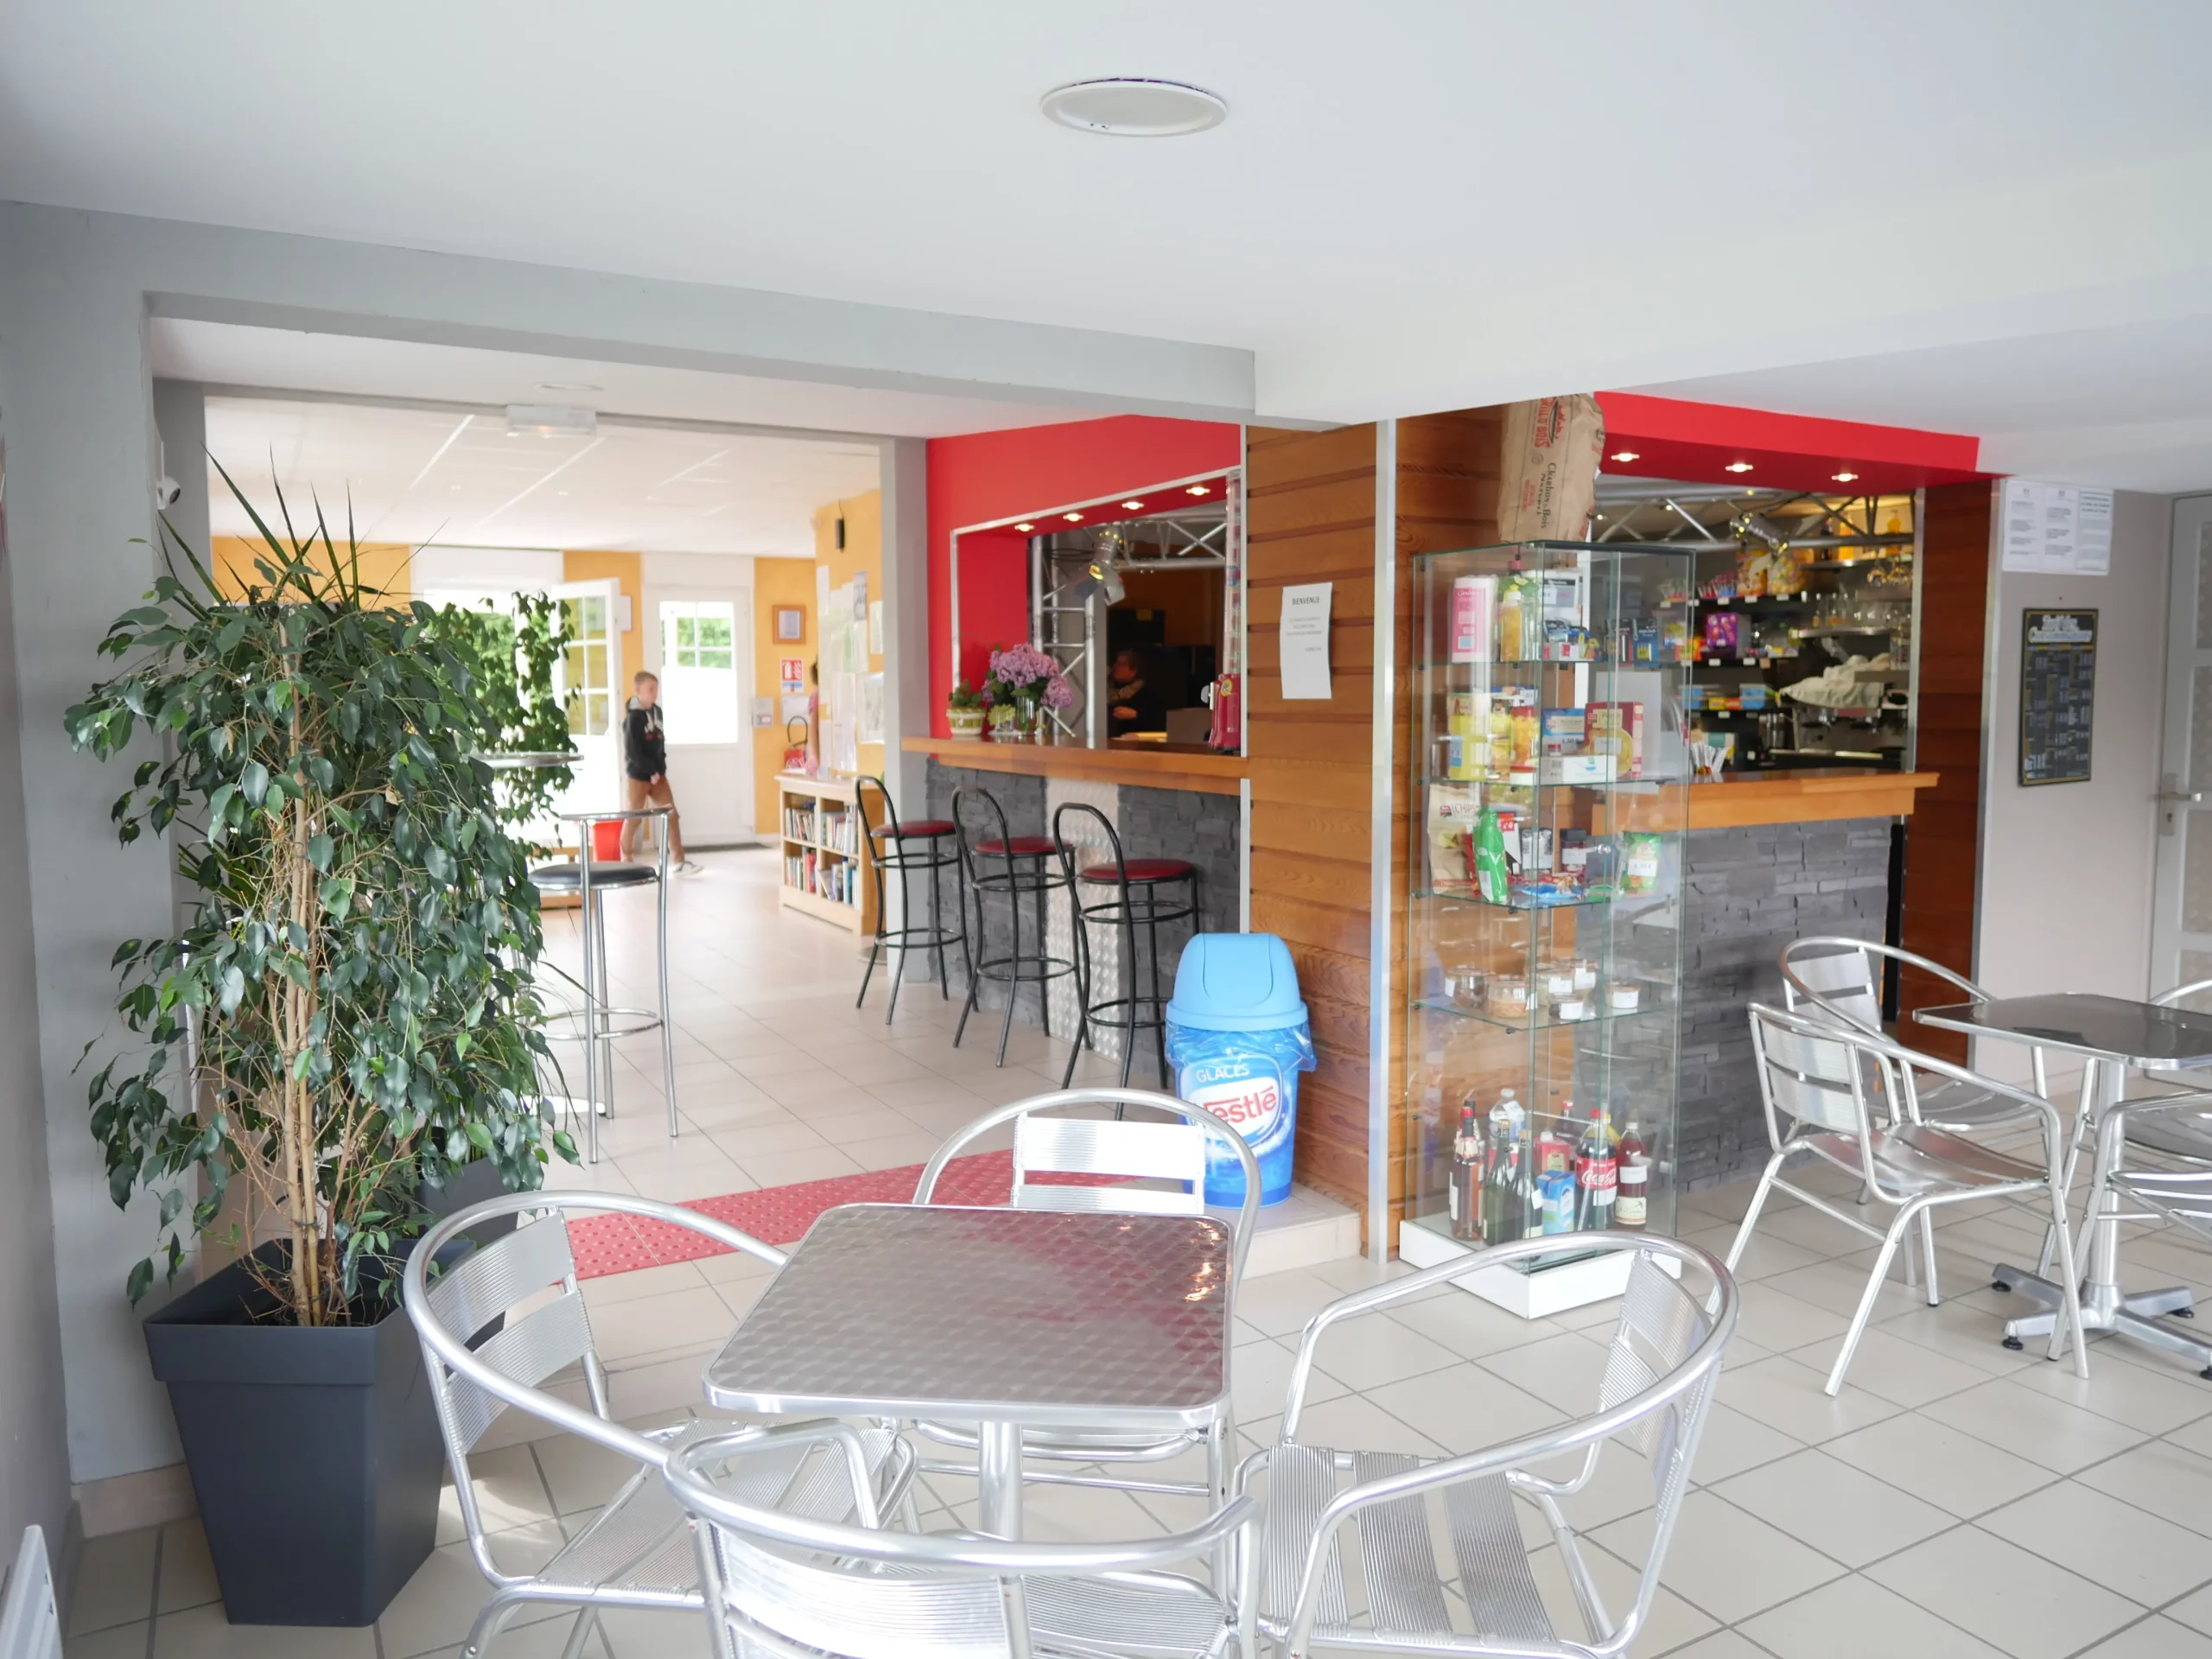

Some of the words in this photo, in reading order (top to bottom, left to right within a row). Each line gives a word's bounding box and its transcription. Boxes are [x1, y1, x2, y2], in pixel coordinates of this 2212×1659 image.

[1541, 508, 1552, 529] Bois
[1292, 596, 1320, 605] BIENVENUE
[1454, 804, 1477, 814] CHIPS
[1197, 1064, 1249, 1083] GLACES
[1203, 1086, 1276, 1123] estlé
[1581, 1169, 1617, 1185] Coca-Col
